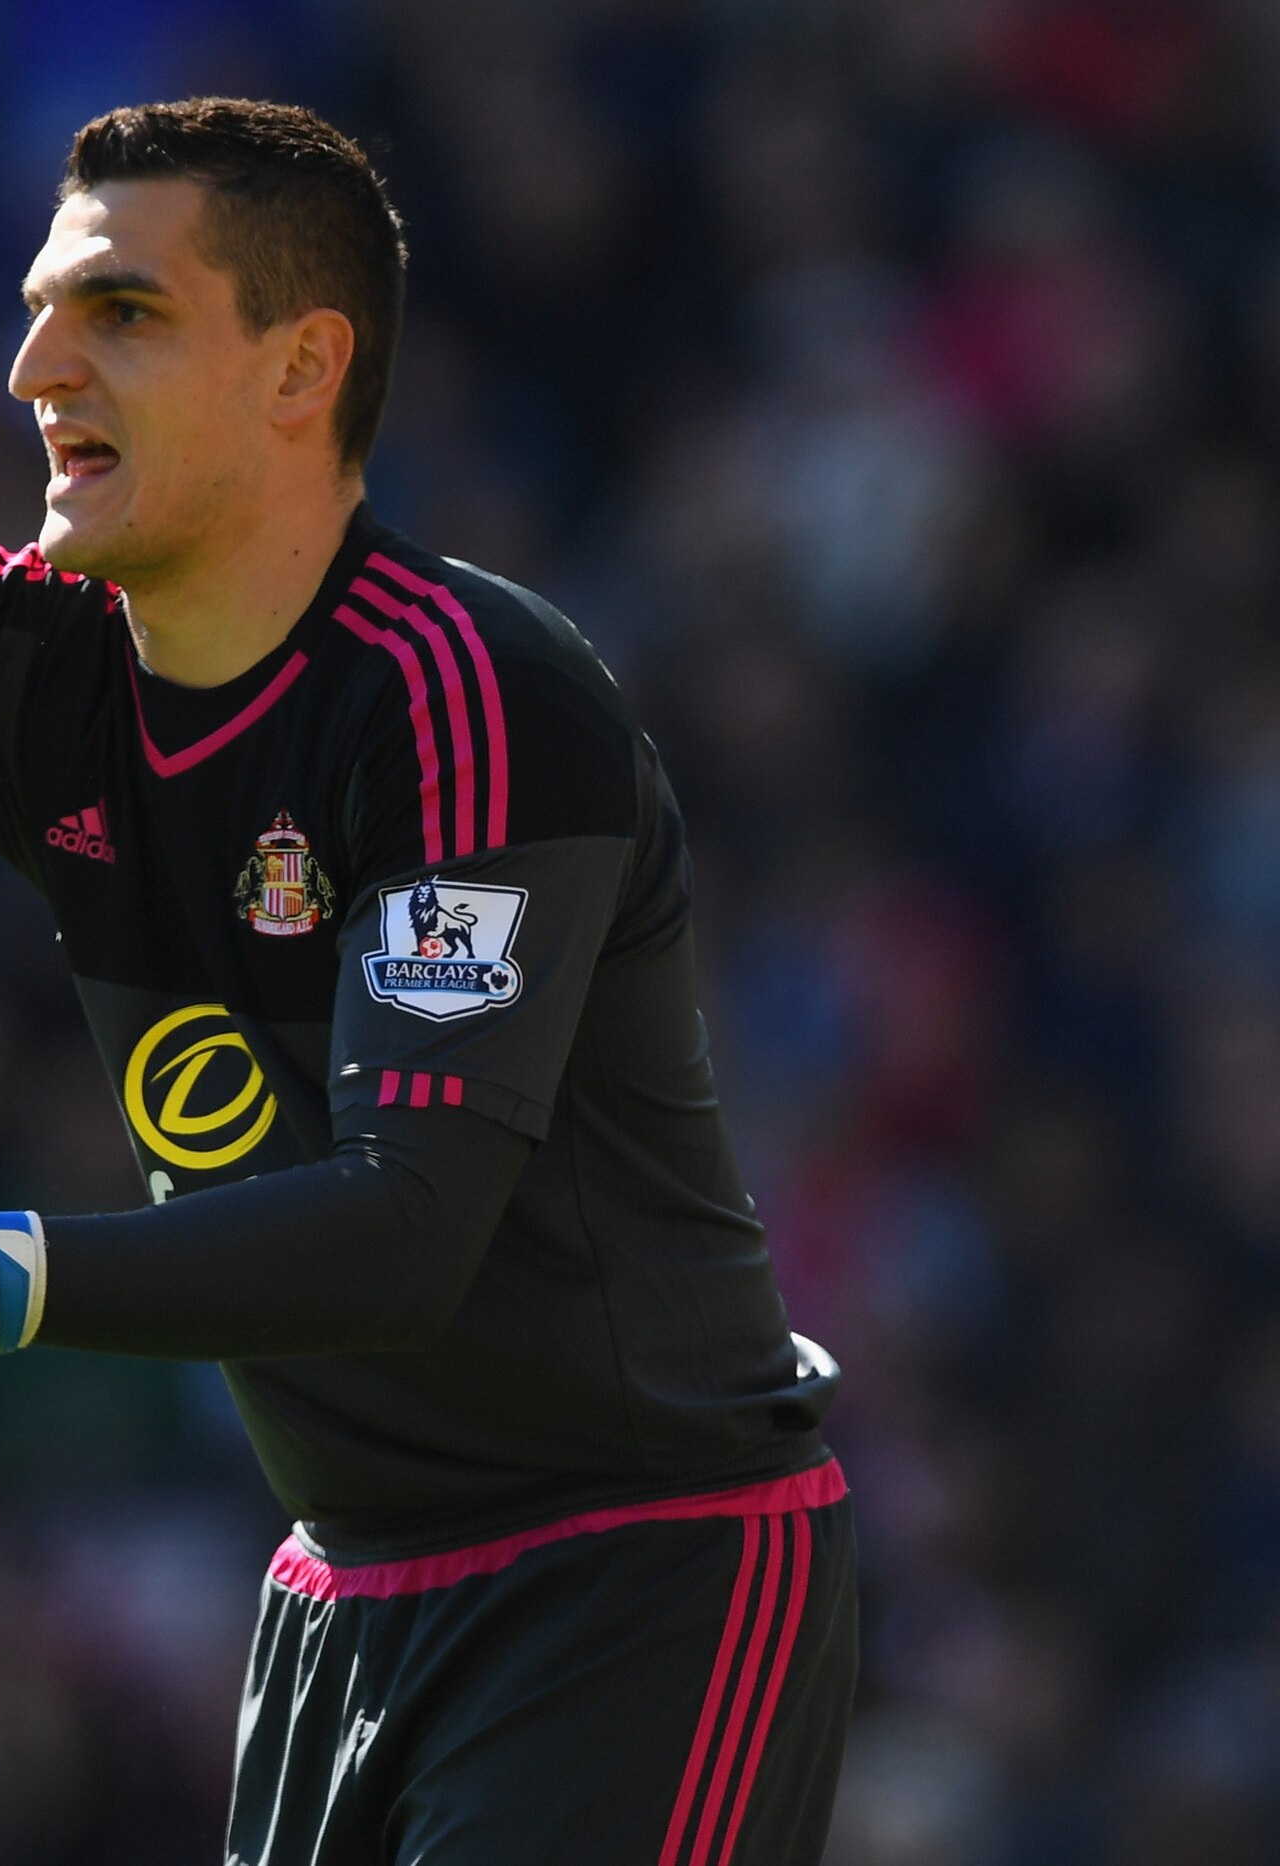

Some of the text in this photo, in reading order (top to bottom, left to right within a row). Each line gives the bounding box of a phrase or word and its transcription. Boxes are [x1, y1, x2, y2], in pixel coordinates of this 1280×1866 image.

[386, 962, 478, 980] BARCLAYS
[384, 978, 477, 990] PREMIER LEAGUE
